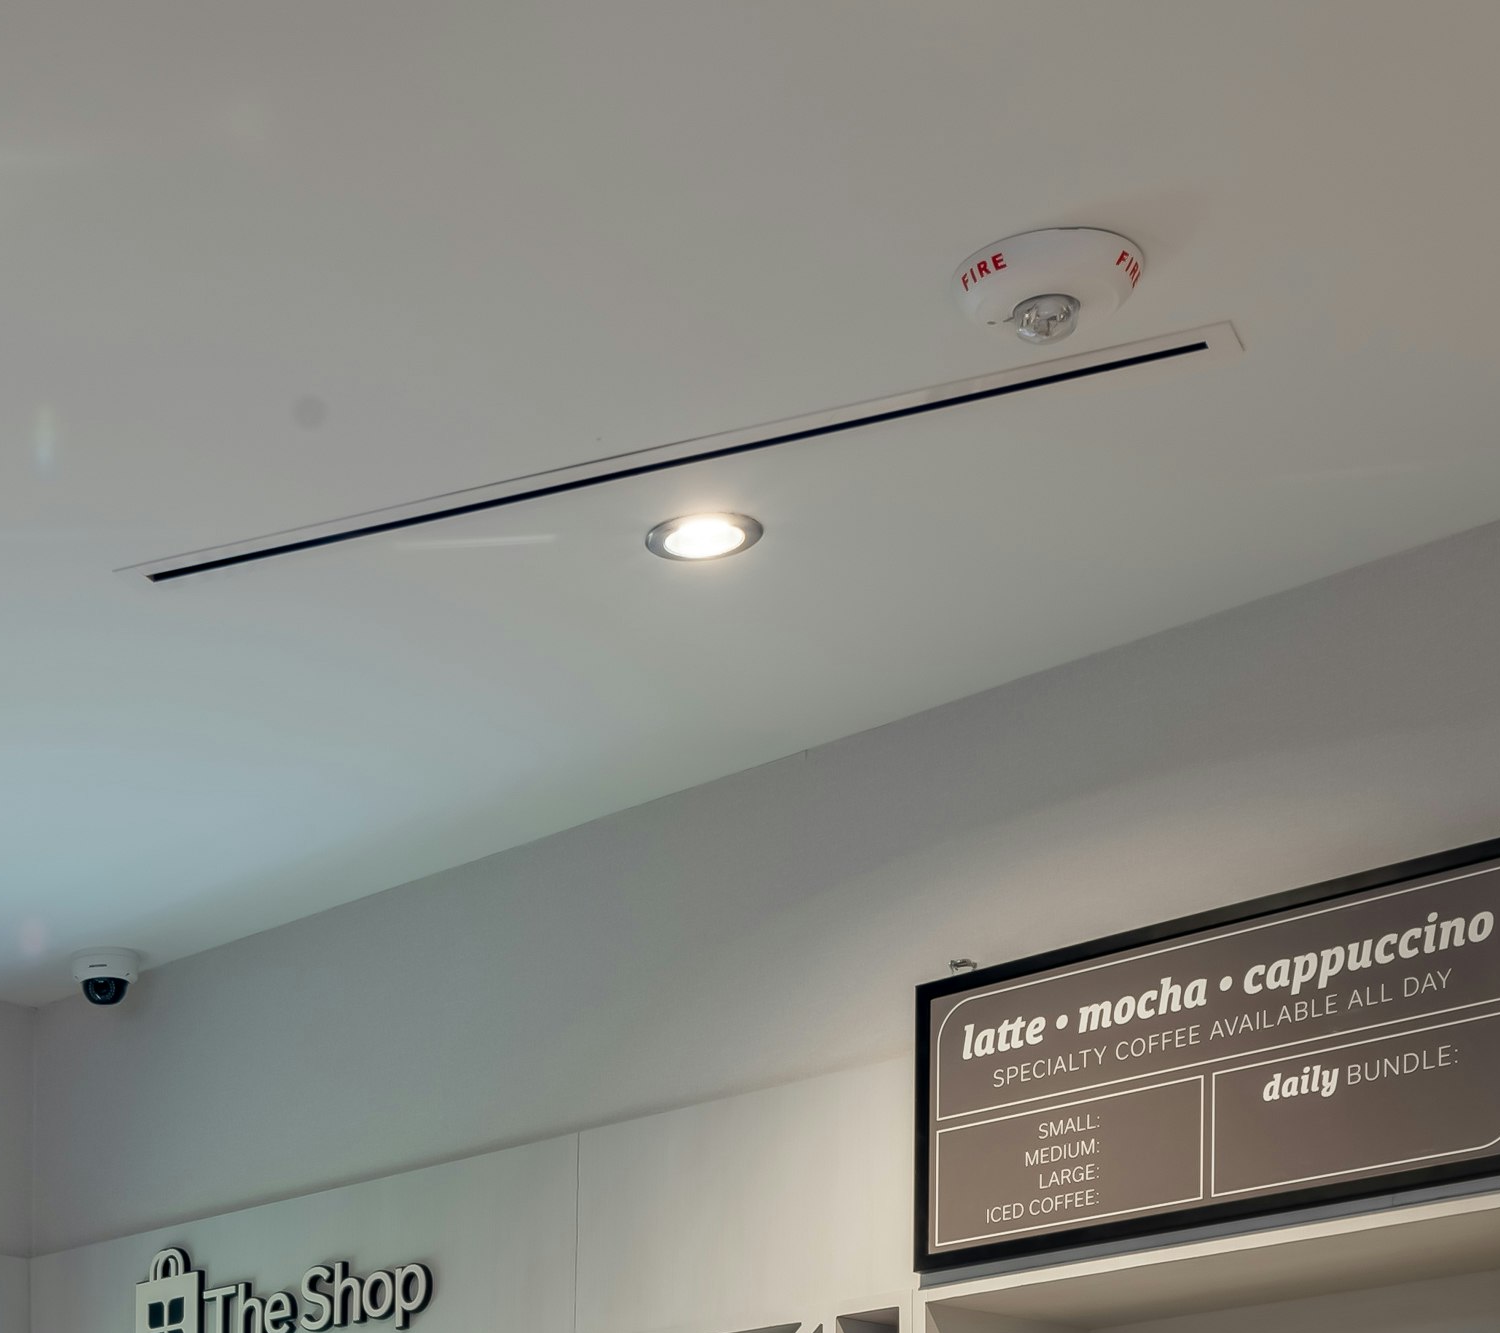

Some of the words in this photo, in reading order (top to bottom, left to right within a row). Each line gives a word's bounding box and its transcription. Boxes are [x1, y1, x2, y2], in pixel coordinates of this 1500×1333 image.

[961, 253, 1007, 292] FIRE
[962, 1013, 1046, 1061] latte
[1077, 972, 1208, 1034] mocha
[1242, 909, 1495, 996] cappuccino
[992, 1046, 1107, 1090] SPECIALTY
[1115, 1024, 1202, 1062] COFFEE
[1209, 993, 1339, 1042] AVAILABLE
[1347, 982, 1394, 1012] ALL
[1402, 967, 1454, 999] DAY
[1262, 1063, 1340, 1103] daily
[1346, 1044, 1460, 1087] BUNDLE:
[1037, 1115, 1101, 1141] SMALL:
[1024, 1138, 1101, 1168] MEDIUM:
[1038, 1164, 1101, 1190] LARGE:
[985, 1199, 1025, 1225] ICED
[1028, 1188, 1101, 1218] COFFEE:
[300, 1260, 434, 1333] Shop
